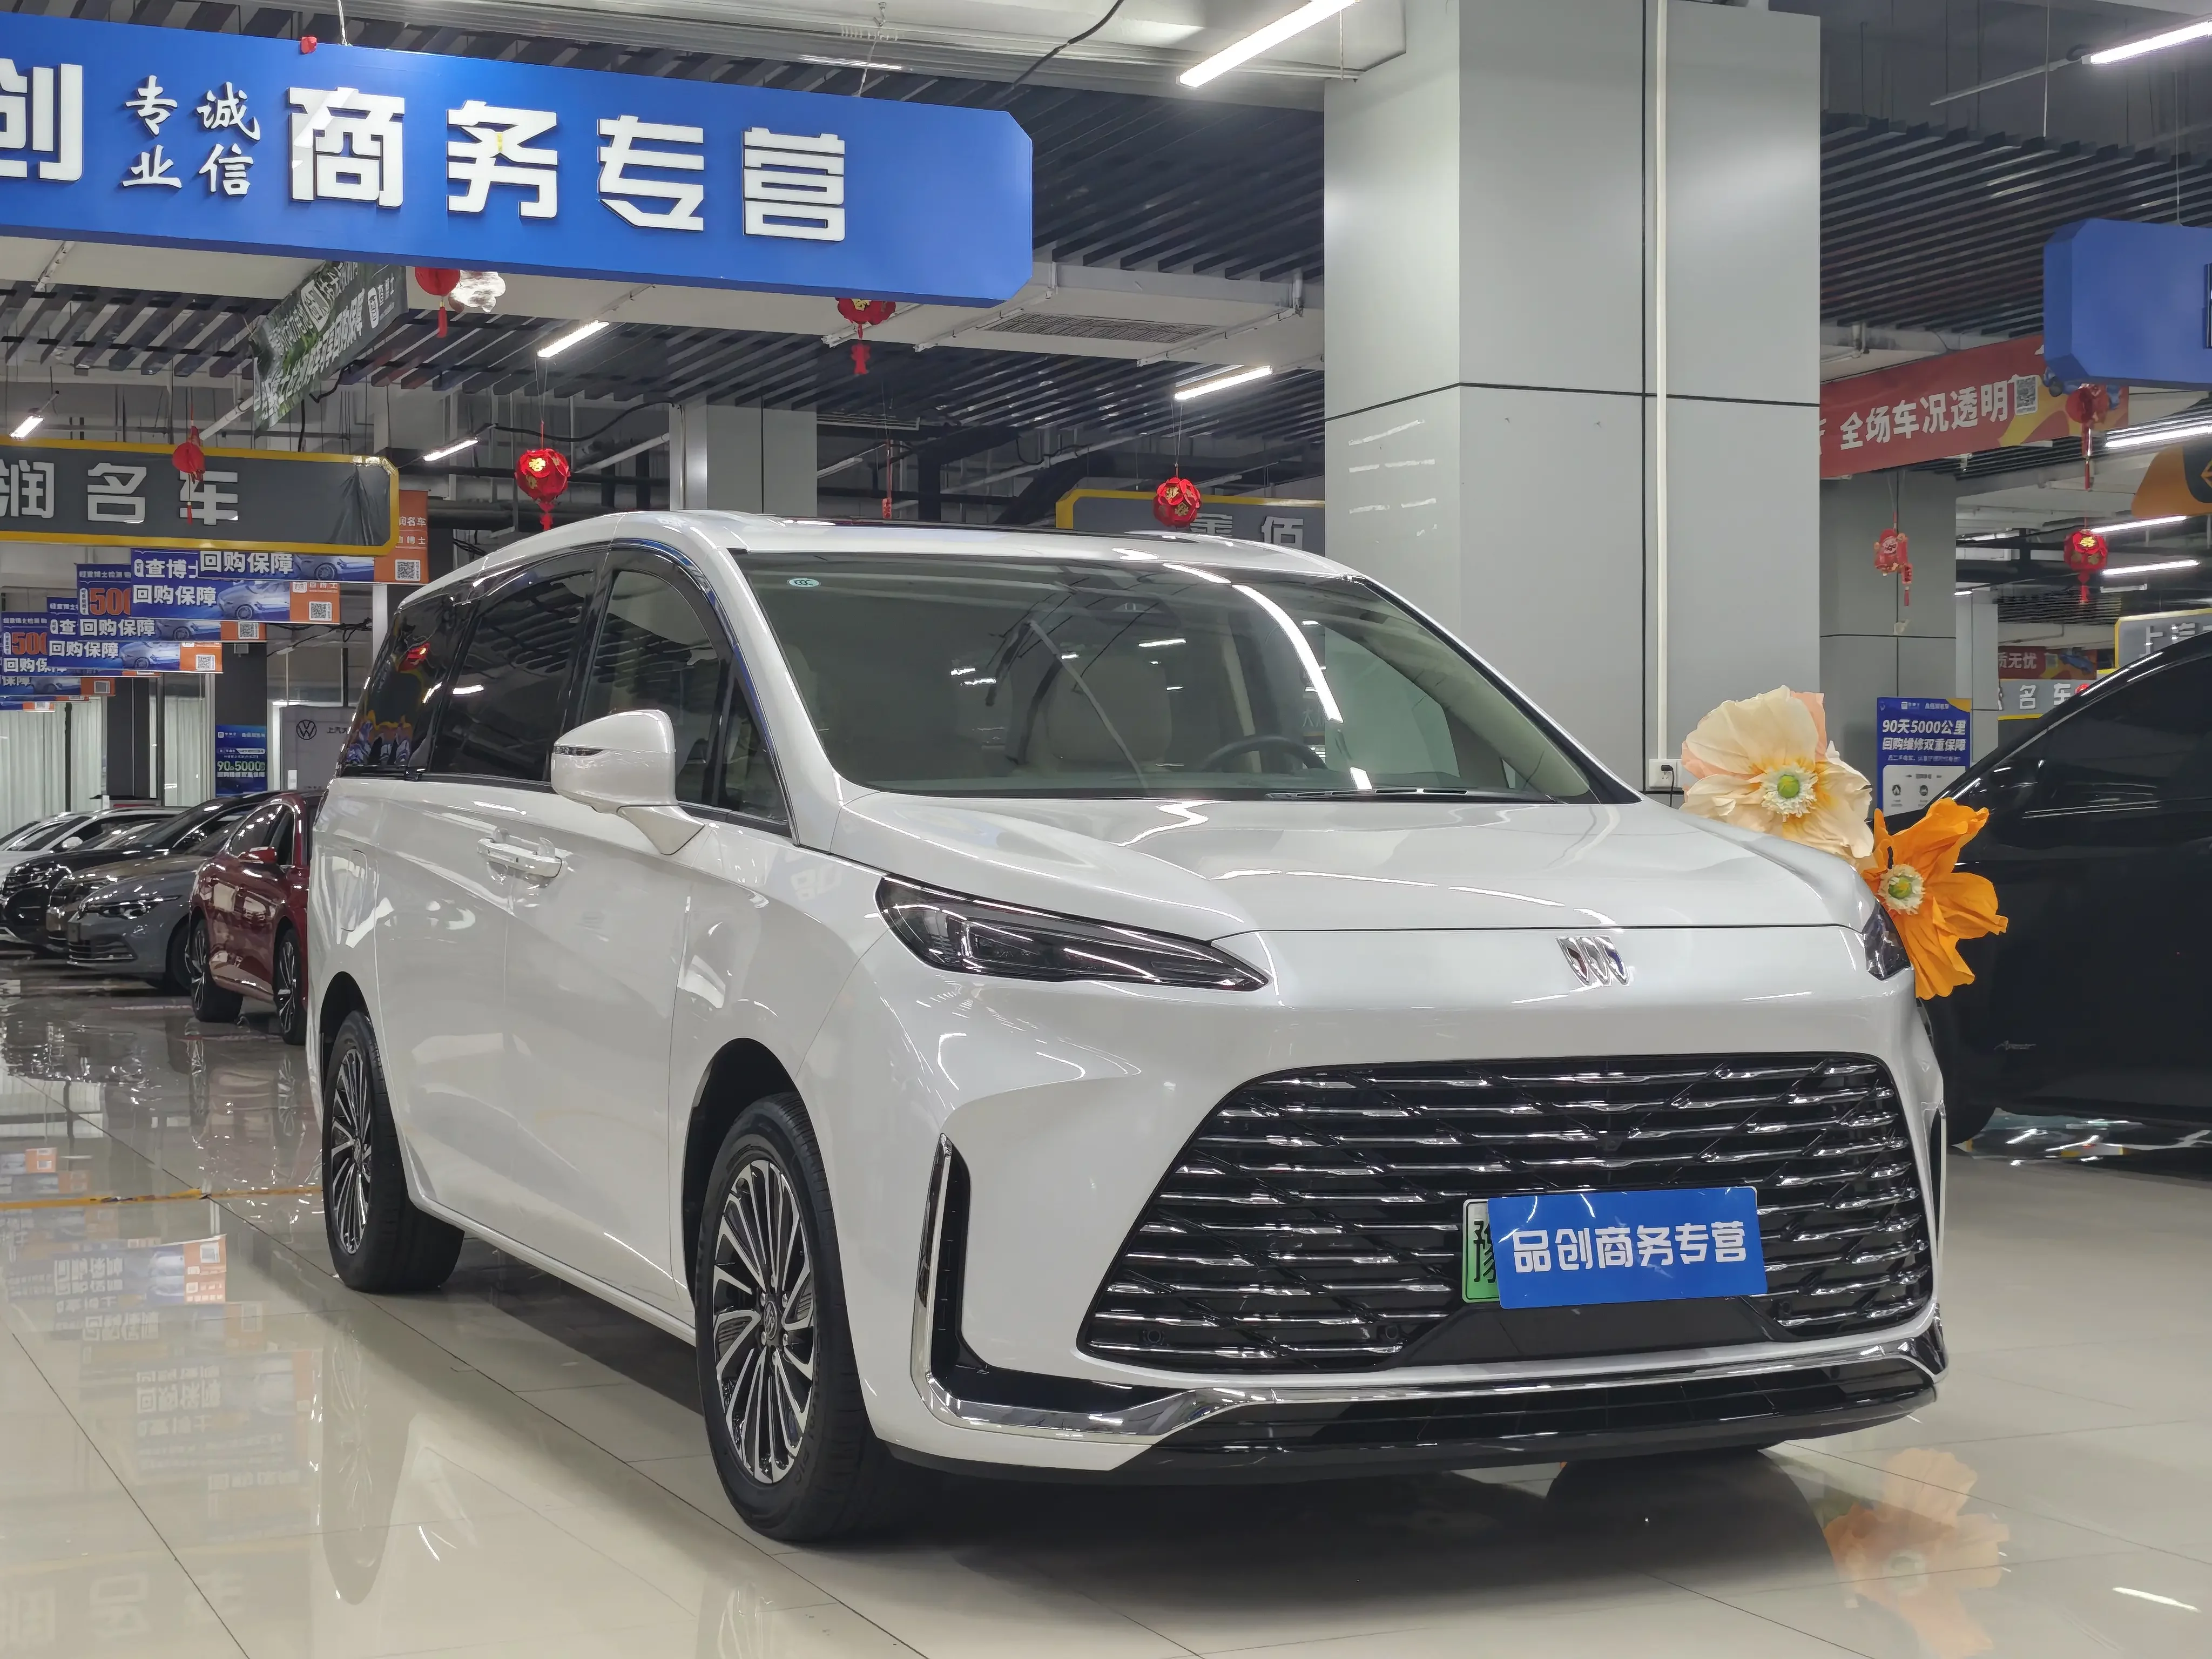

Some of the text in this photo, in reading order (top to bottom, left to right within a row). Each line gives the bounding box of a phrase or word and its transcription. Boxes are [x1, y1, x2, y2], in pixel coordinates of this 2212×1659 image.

[288, 86, 845, 241] 商务专营
[1839, 380, 2009, 450] 全场车况透明
[0, 458, 239, 526] 润名车
[200, 550, 293, 575] 回购保障
[133, 584, 217, 606] 回购保障
[79, 618, 156, 637] 回购保障
[49, 640, 119, 659] 回购保障
[1881, 719, 1966, 736] 90天5000公里
[1512, 1220, 1746, 1273] 品创商务专营
